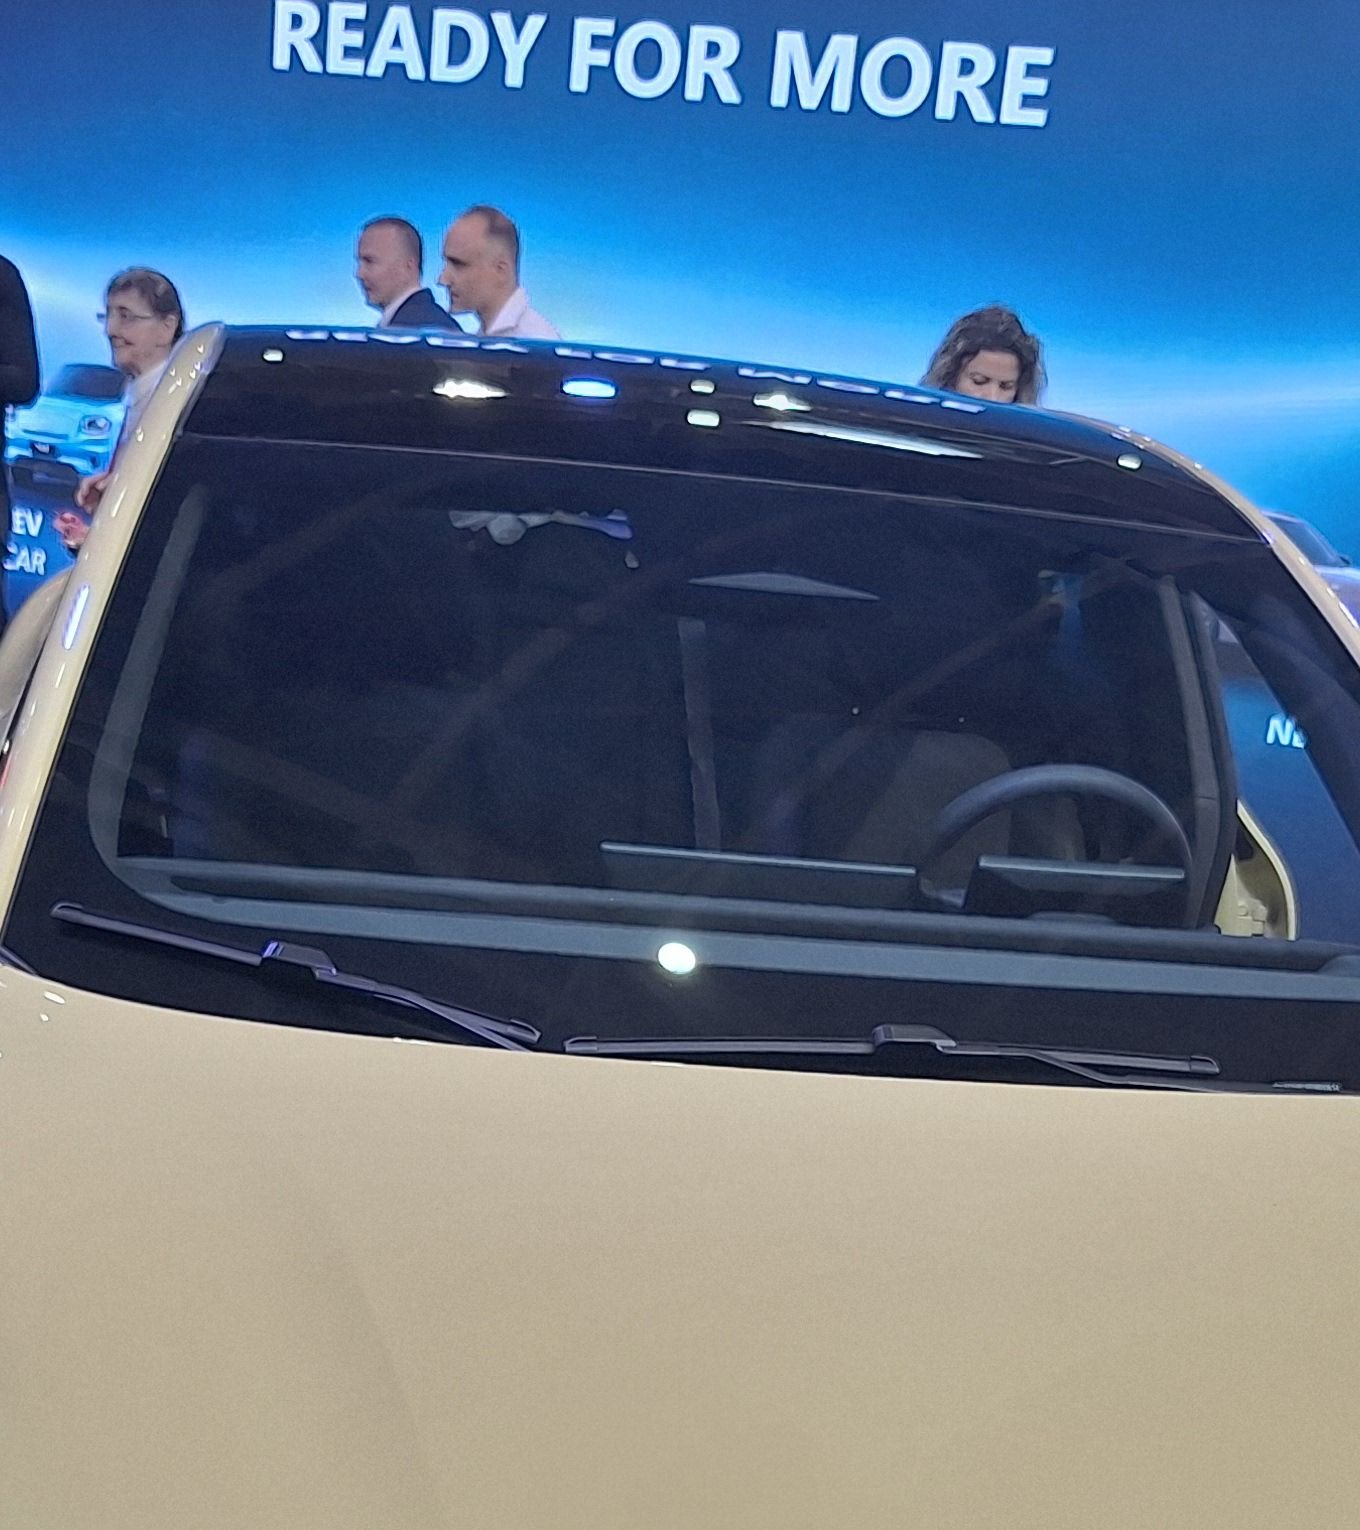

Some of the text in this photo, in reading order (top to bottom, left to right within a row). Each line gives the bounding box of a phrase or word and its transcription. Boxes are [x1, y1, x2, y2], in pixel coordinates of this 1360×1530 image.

[272, 0, 1055, 128] READY FOR MORE
[11, 506, 44, 537] EV
